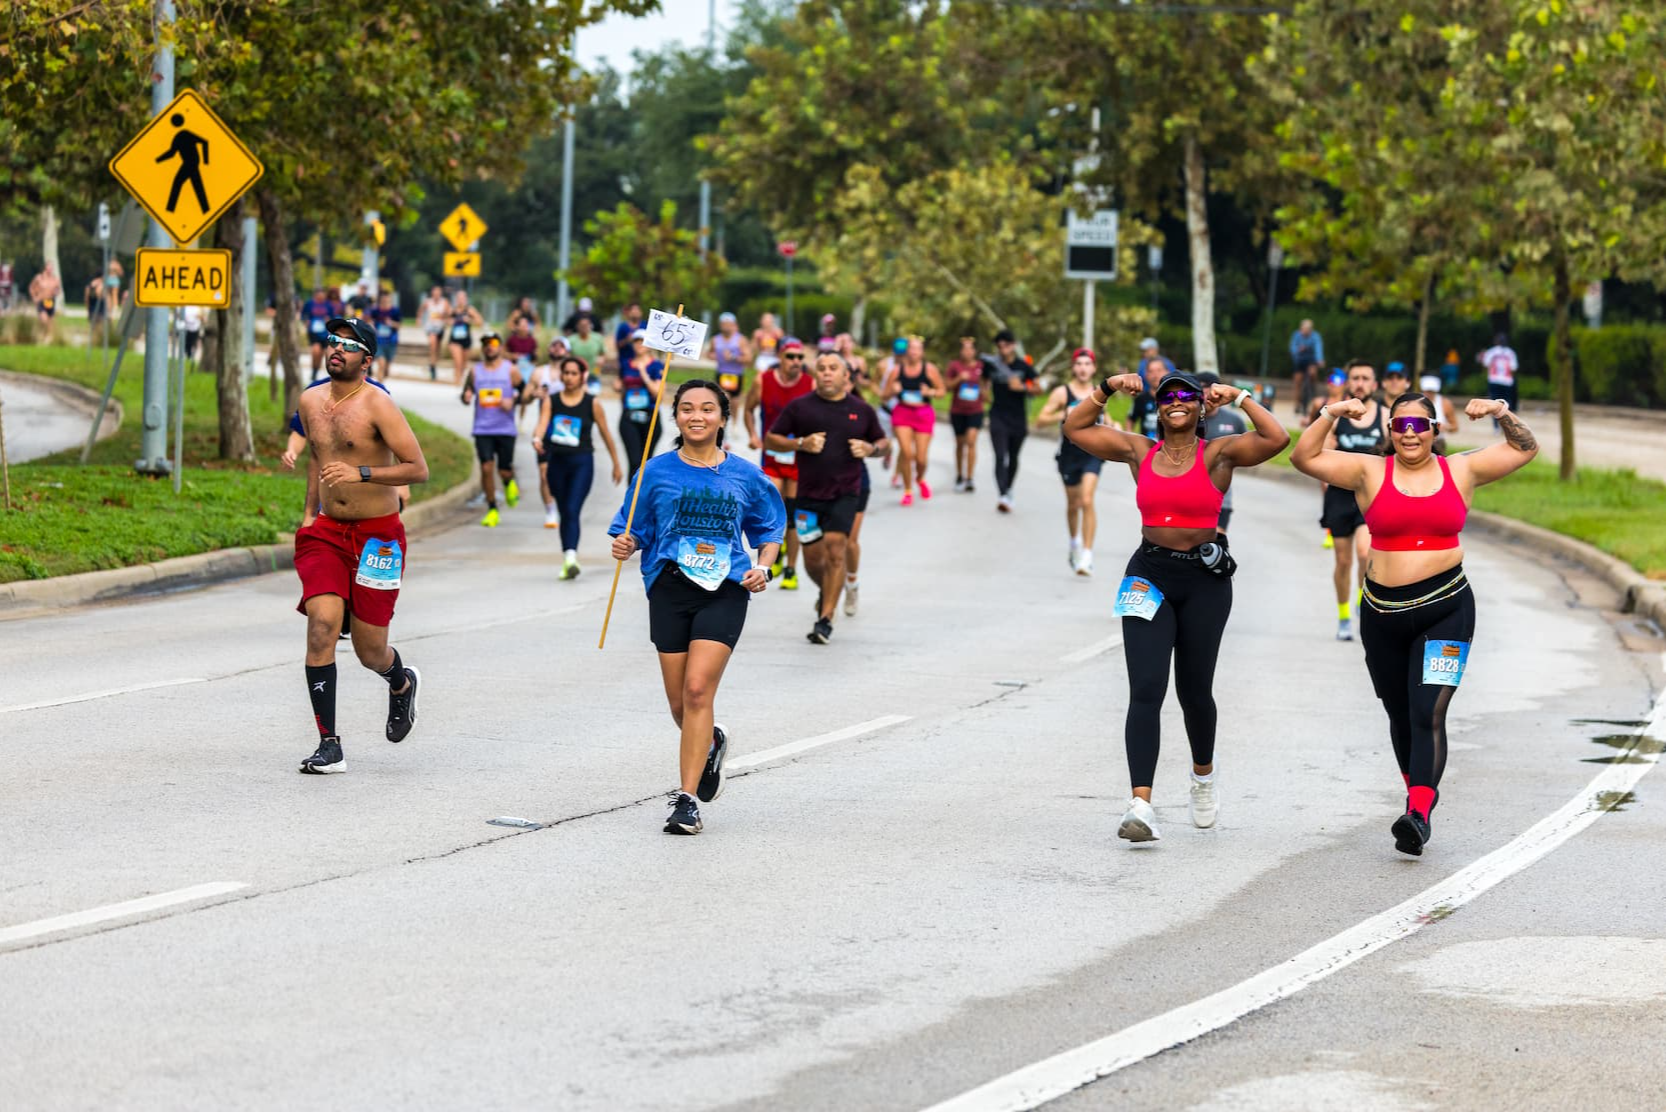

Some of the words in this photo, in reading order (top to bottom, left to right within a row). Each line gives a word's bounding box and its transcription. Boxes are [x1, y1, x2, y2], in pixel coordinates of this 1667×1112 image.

[143, 265, 223, 290] AHEAD
[672, 511, 733, 532] Houston
[366, 553, 393, 570] 8162
[684, 554, 716, 571] 8772
[1170, 551, 1201, 560] FITLE
[1119, 591, 1146, 606] 7125
[1430, 657, 1460, 673] 8828
